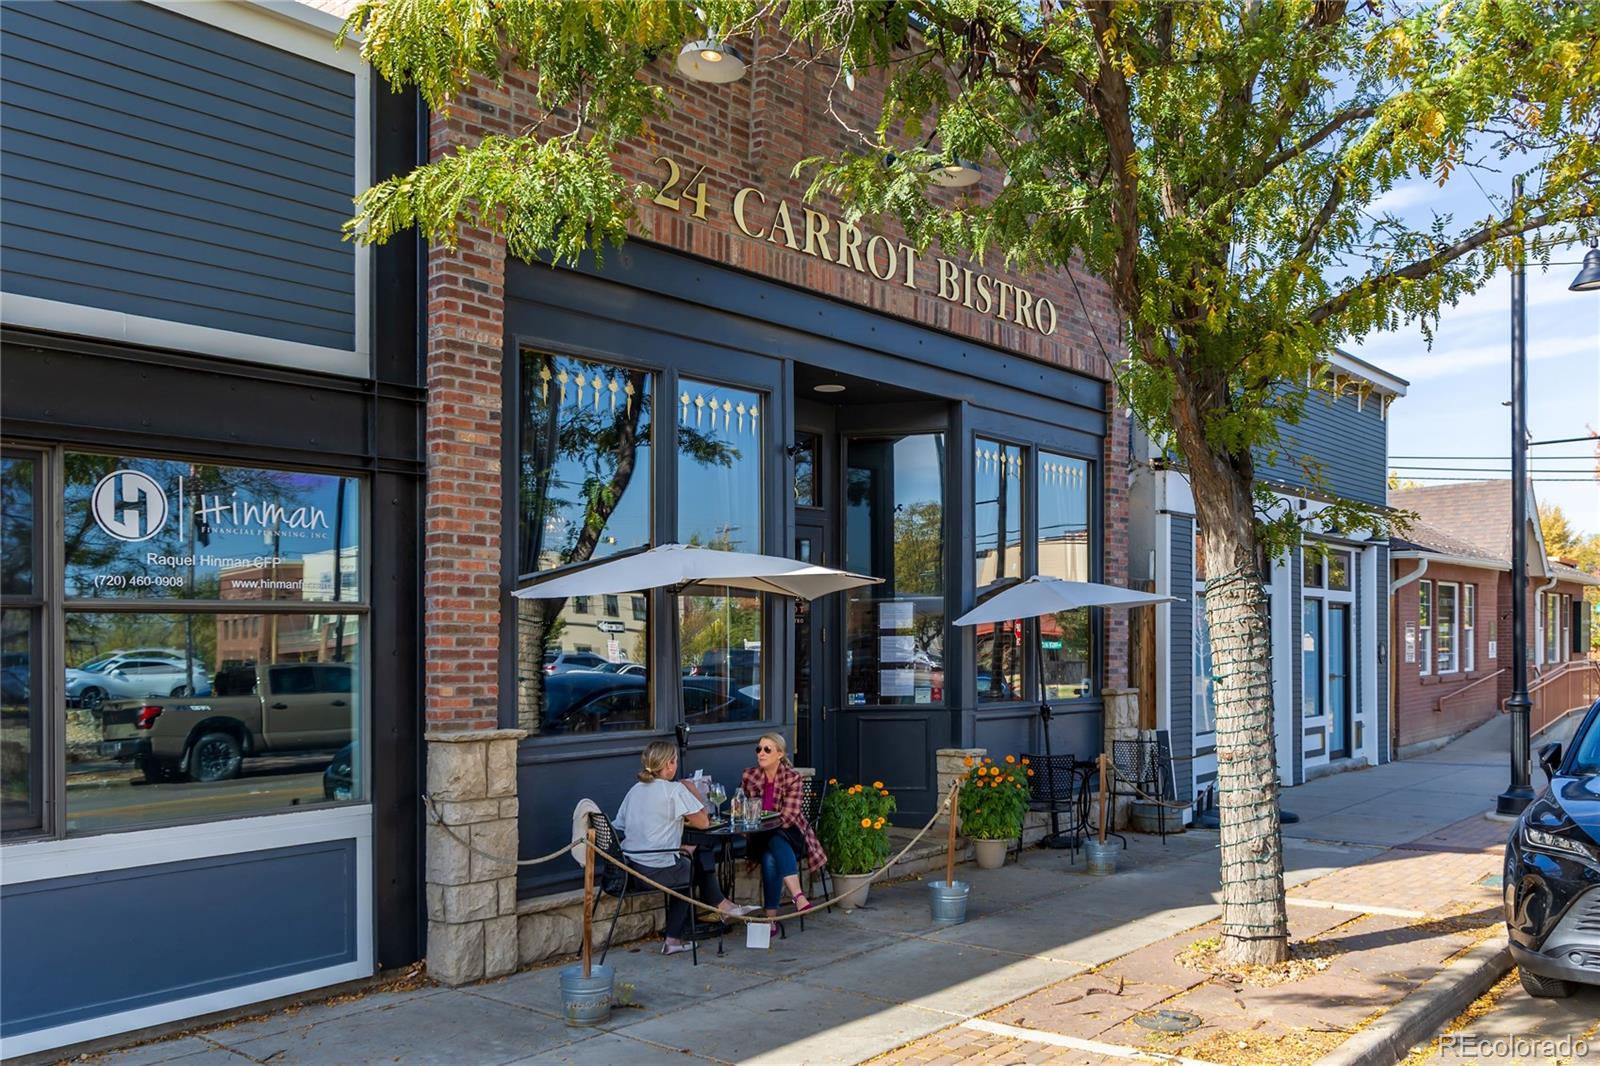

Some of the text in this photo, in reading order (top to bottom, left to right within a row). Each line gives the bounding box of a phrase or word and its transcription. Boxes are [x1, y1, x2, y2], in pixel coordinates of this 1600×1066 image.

[653, 156, 1057, 336] 24 CARROT BISTRO
[194, 491, 329, 530] Hinman
[147, 552, 196, 568] Raquel
[200, 554, 249, 567] Hinman
[94, 575, 184, 588] (720) 460-0908
